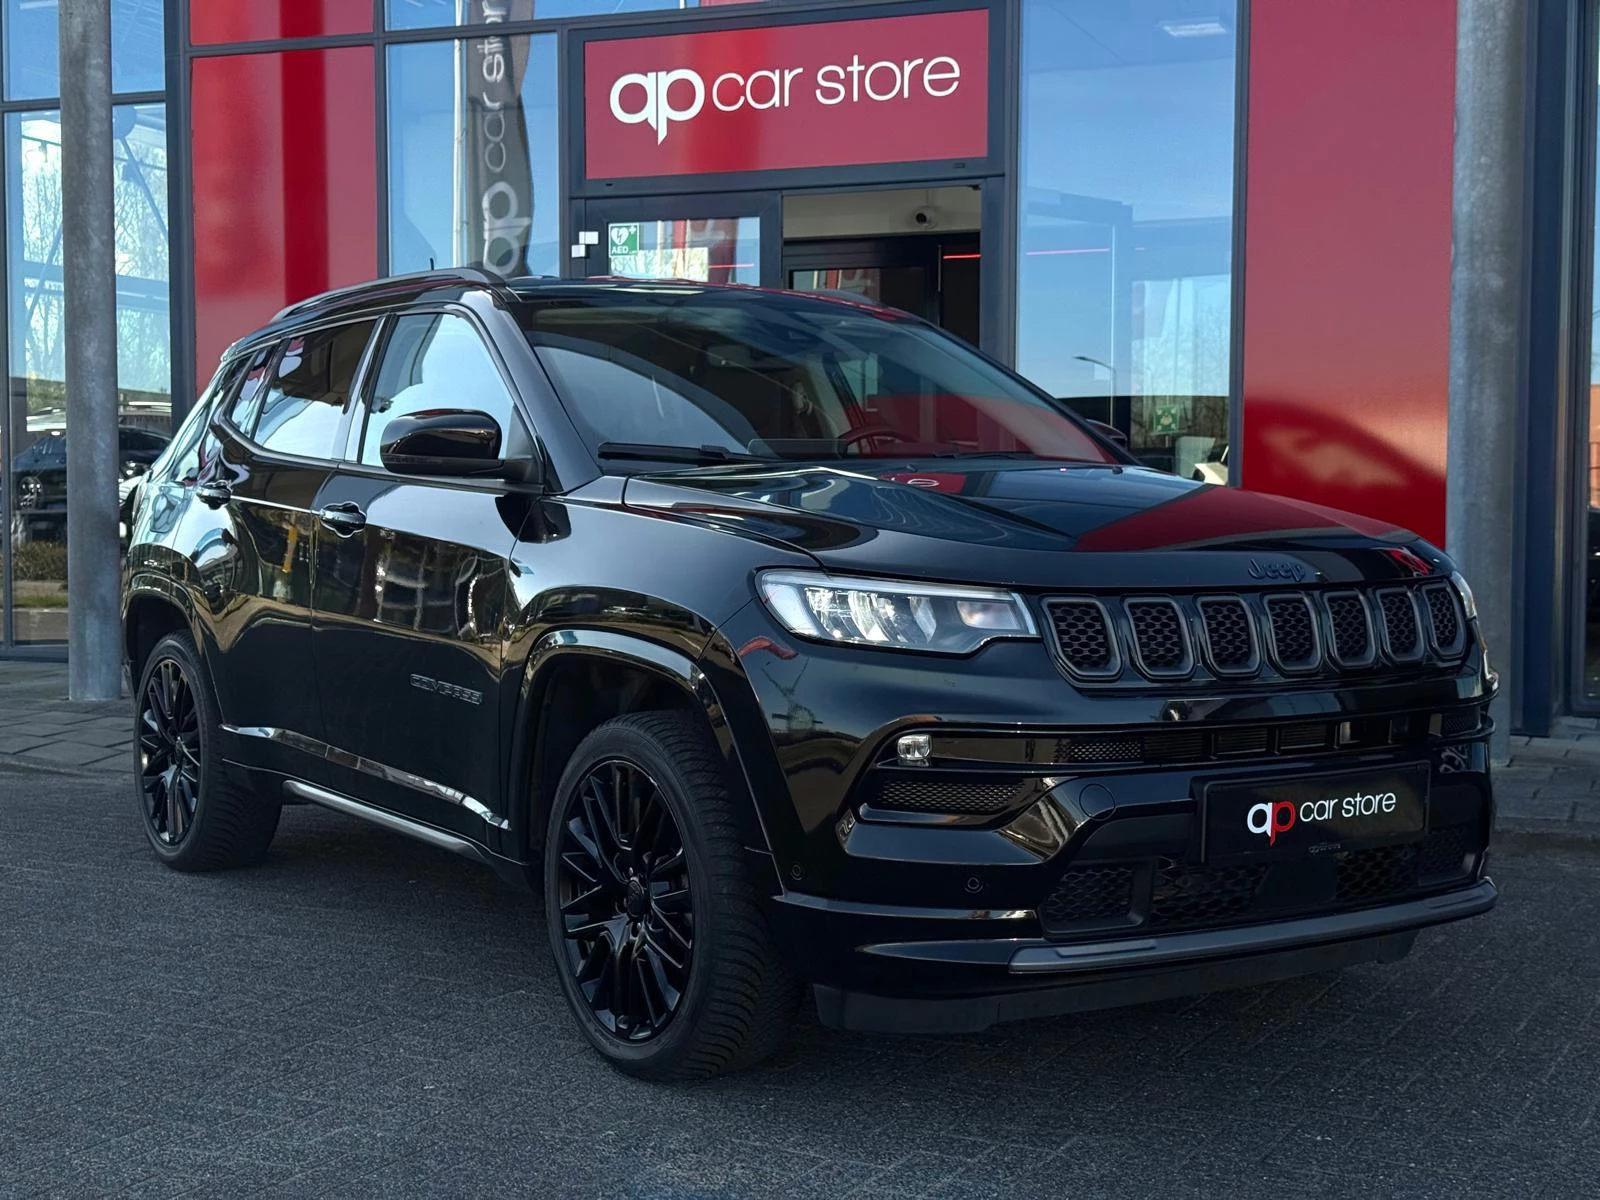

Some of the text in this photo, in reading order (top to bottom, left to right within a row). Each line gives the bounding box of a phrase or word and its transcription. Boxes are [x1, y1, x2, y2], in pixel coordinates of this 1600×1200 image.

[609, 54, 961, 147] ap car store
[482, 91, 507, 173] car
[611, 246, 630, 255] AED
[1248, 559, 1306, 582] Jeep
[410, 673, 483, 705] COMPASS
[1246, 792, 1396, 847] ap car store
